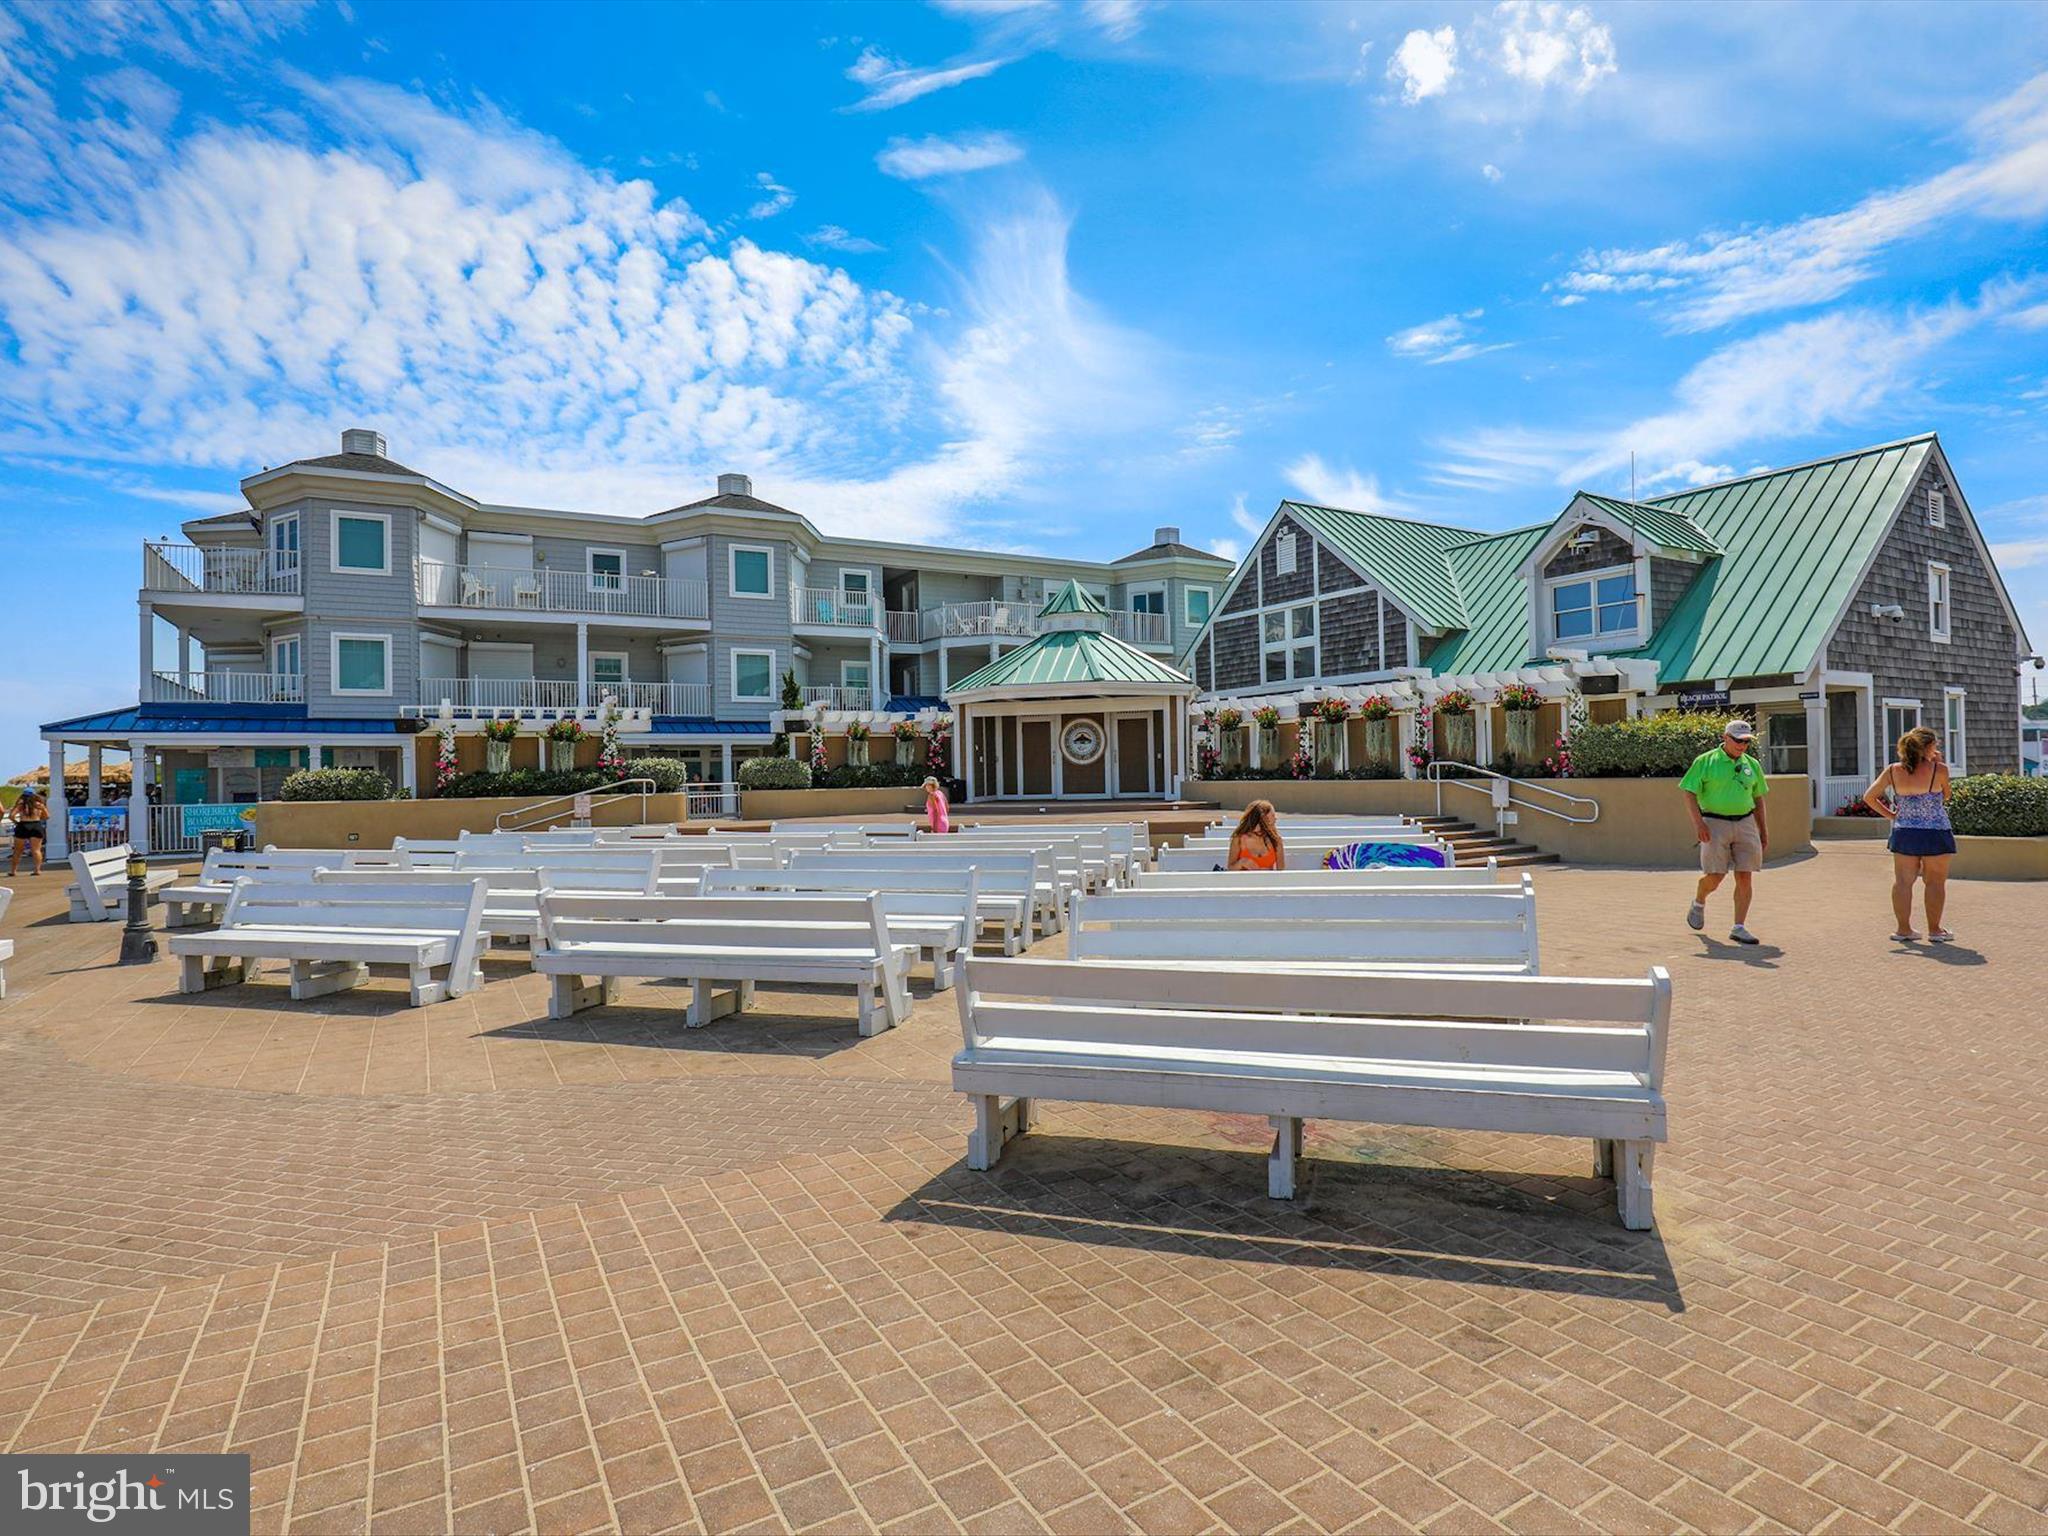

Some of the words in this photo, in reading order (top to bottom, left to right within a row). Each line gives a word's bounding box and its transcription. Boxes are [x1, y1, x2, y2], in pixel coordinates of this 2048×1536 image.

[1702, 692, 1728, 700] PATROL
[185, 807, 238, 817] SHOREBREAK
[187, 816, 237, 826] BOARDWALK
